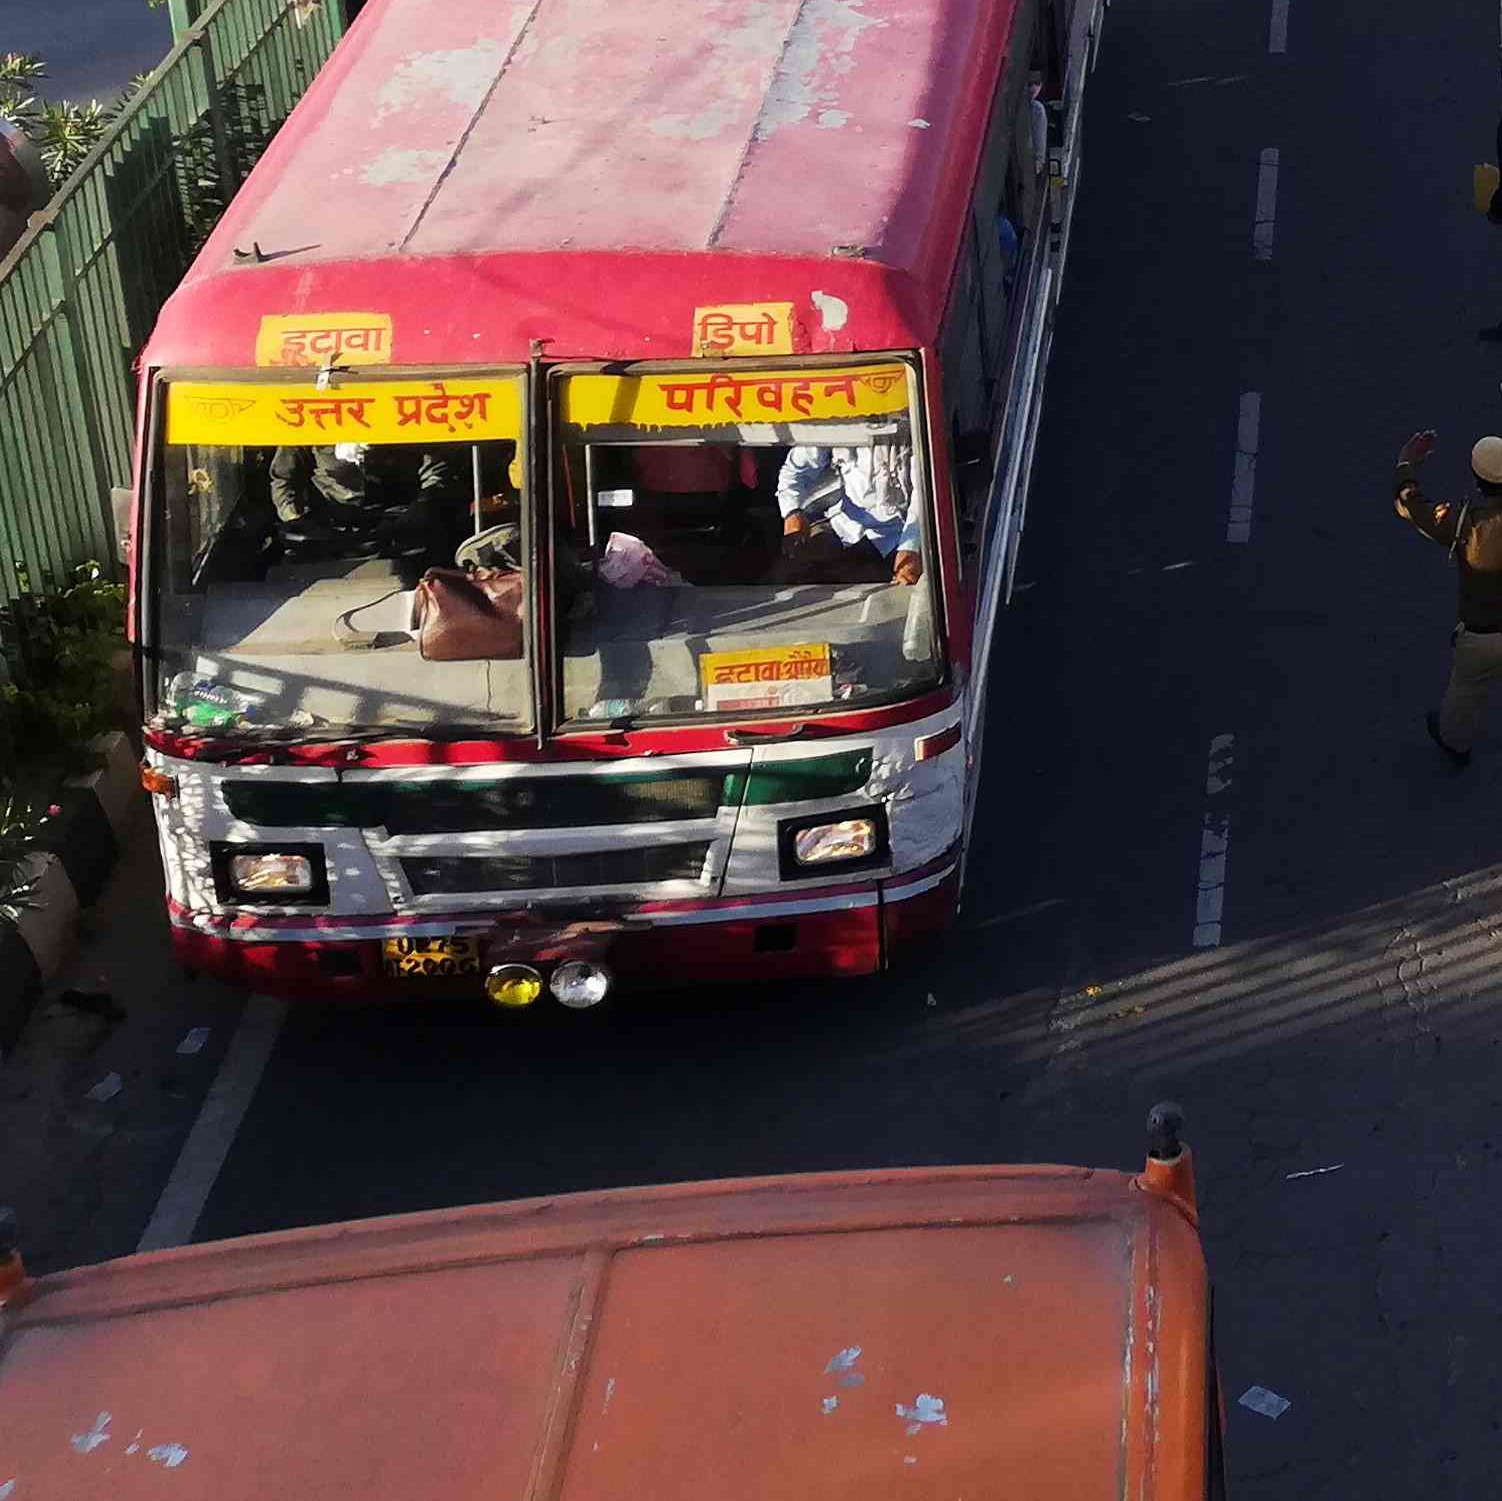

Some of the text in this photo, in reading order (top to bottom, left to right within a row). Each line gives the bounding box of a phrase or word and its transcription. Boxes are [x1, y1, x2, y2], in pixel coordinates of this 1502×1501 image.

[278, 312, 778, 364] इटावा डिपो
[276, 374, 863, 433] उत्तर प्रदेश परिवहन
